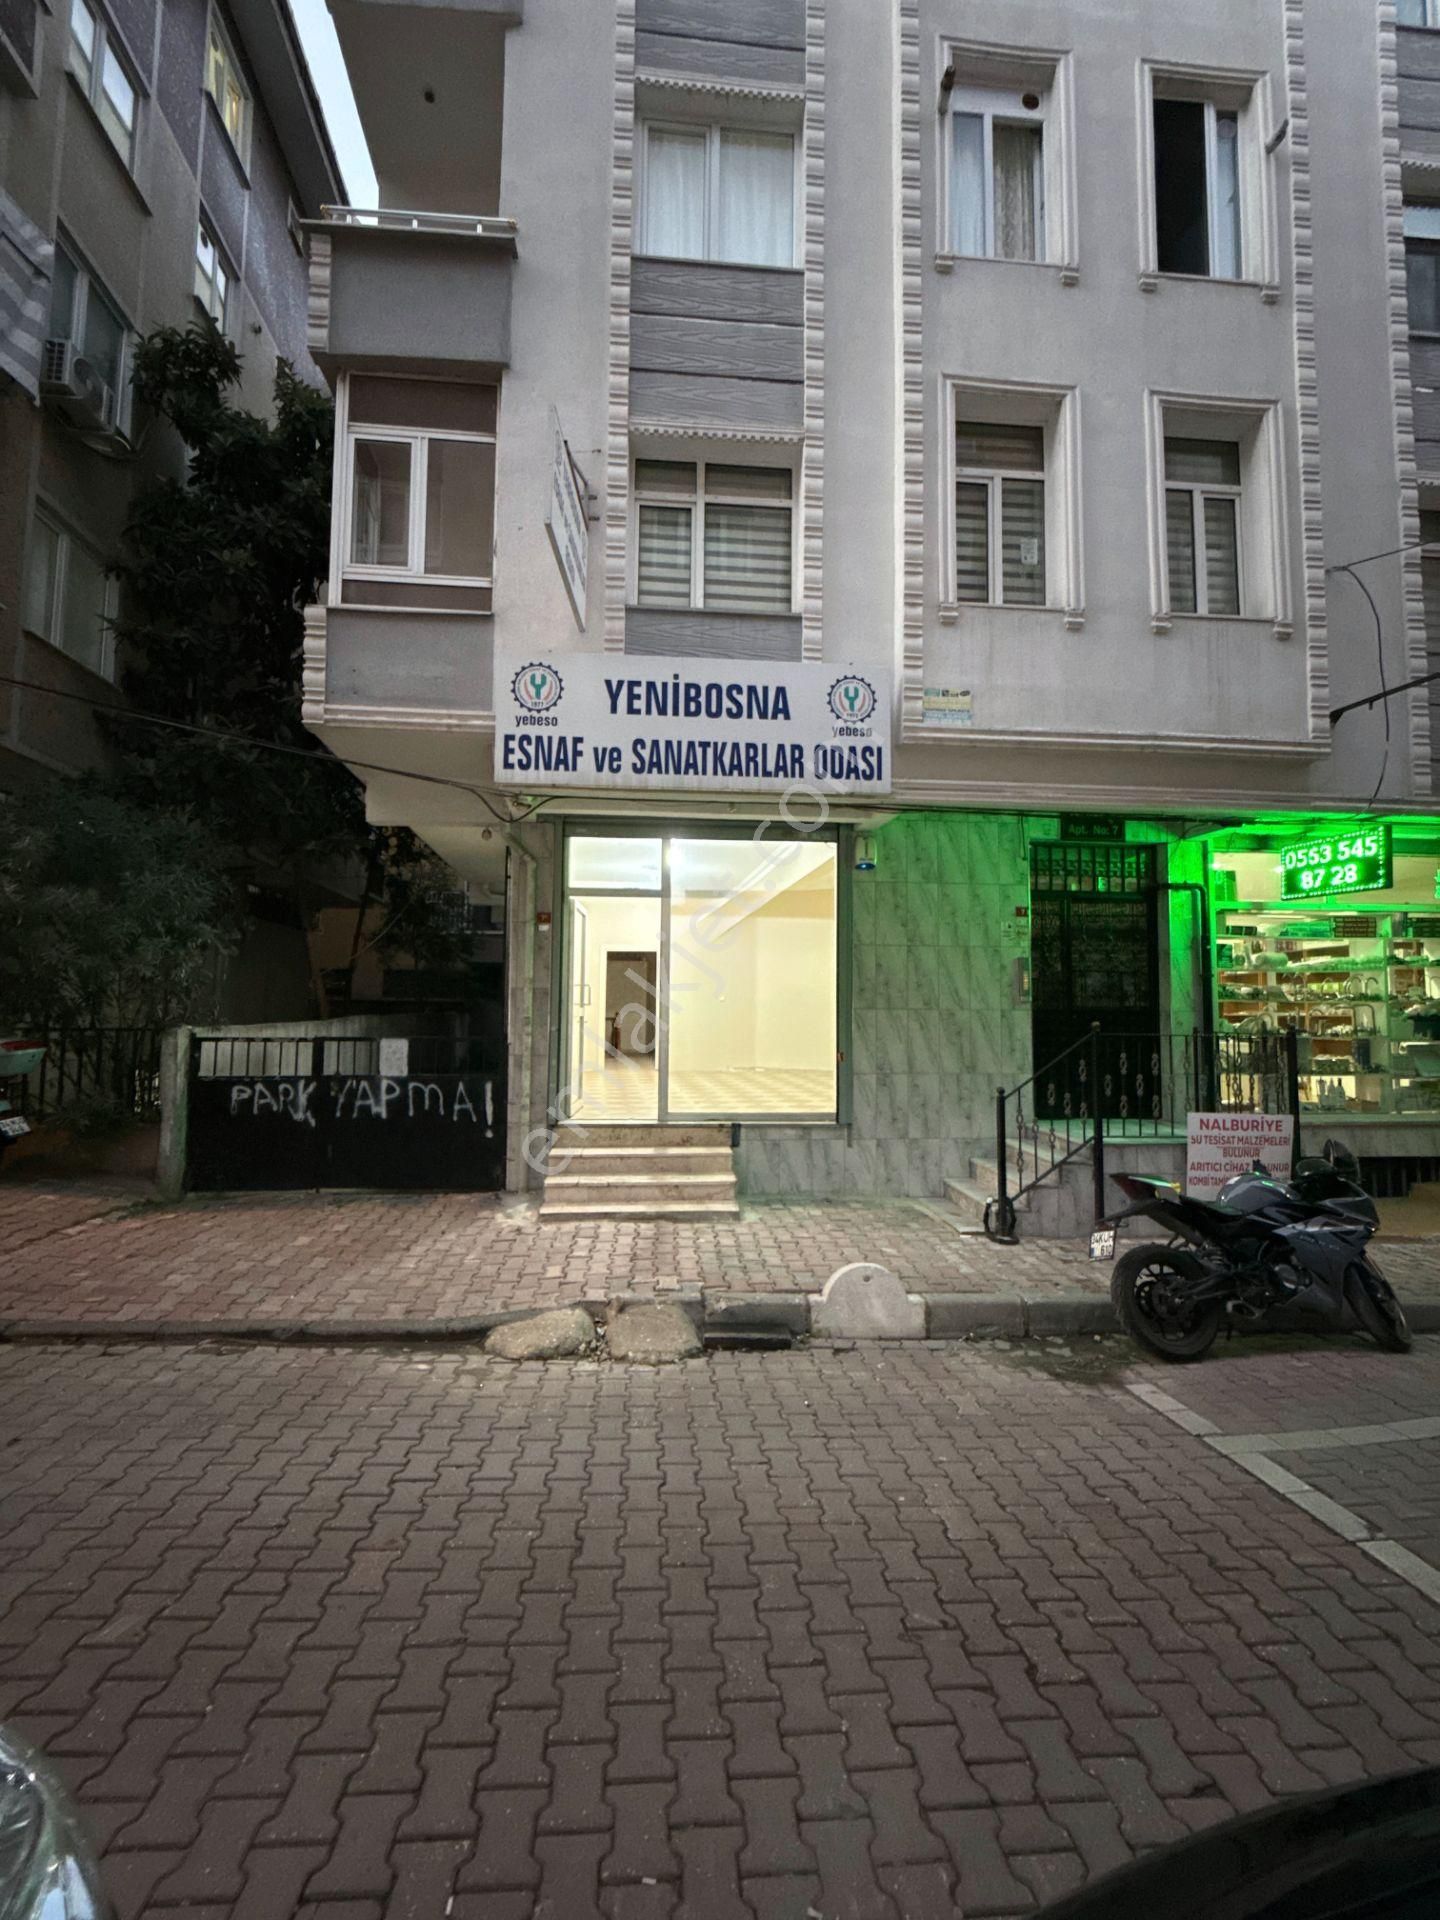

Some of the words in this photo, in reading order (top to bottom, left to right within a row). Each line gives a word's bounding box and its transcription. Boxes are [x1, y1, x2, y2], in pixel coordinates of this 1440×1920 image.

[604, 672, 791, 721] YENİBOSNA
[515, 714, 558, 728] yebeso
[832, 726, 873, 738] yebeso
[502, 733, 584, 773] ESNAF
[593, 746, 622, 774] ve
[632, 738, 805, 779] SANATKARLAR
[813, 743, 883, 781] ODASI
[1285, 845, 1332, 869] 0553
[1336, 836, 1378, 858] 545
[1299, 869, 1324, 889] 87
[1330, 864, 1358, 885] 28
[230, 1079, 317, 1127] PARK
[1199, 1116, 1283, 1132] NALBURİYE
[1190, 1135, 1202, 1144] SU
[1204, 1134, 1236, 1145] TESİSAT
[1237, 1134, 1291, 1146] MALZEMELERİ
[1222, 1147, 1261, 1158] BULUNUR
[1189, 1162, 1222, 1172] ARITICI
